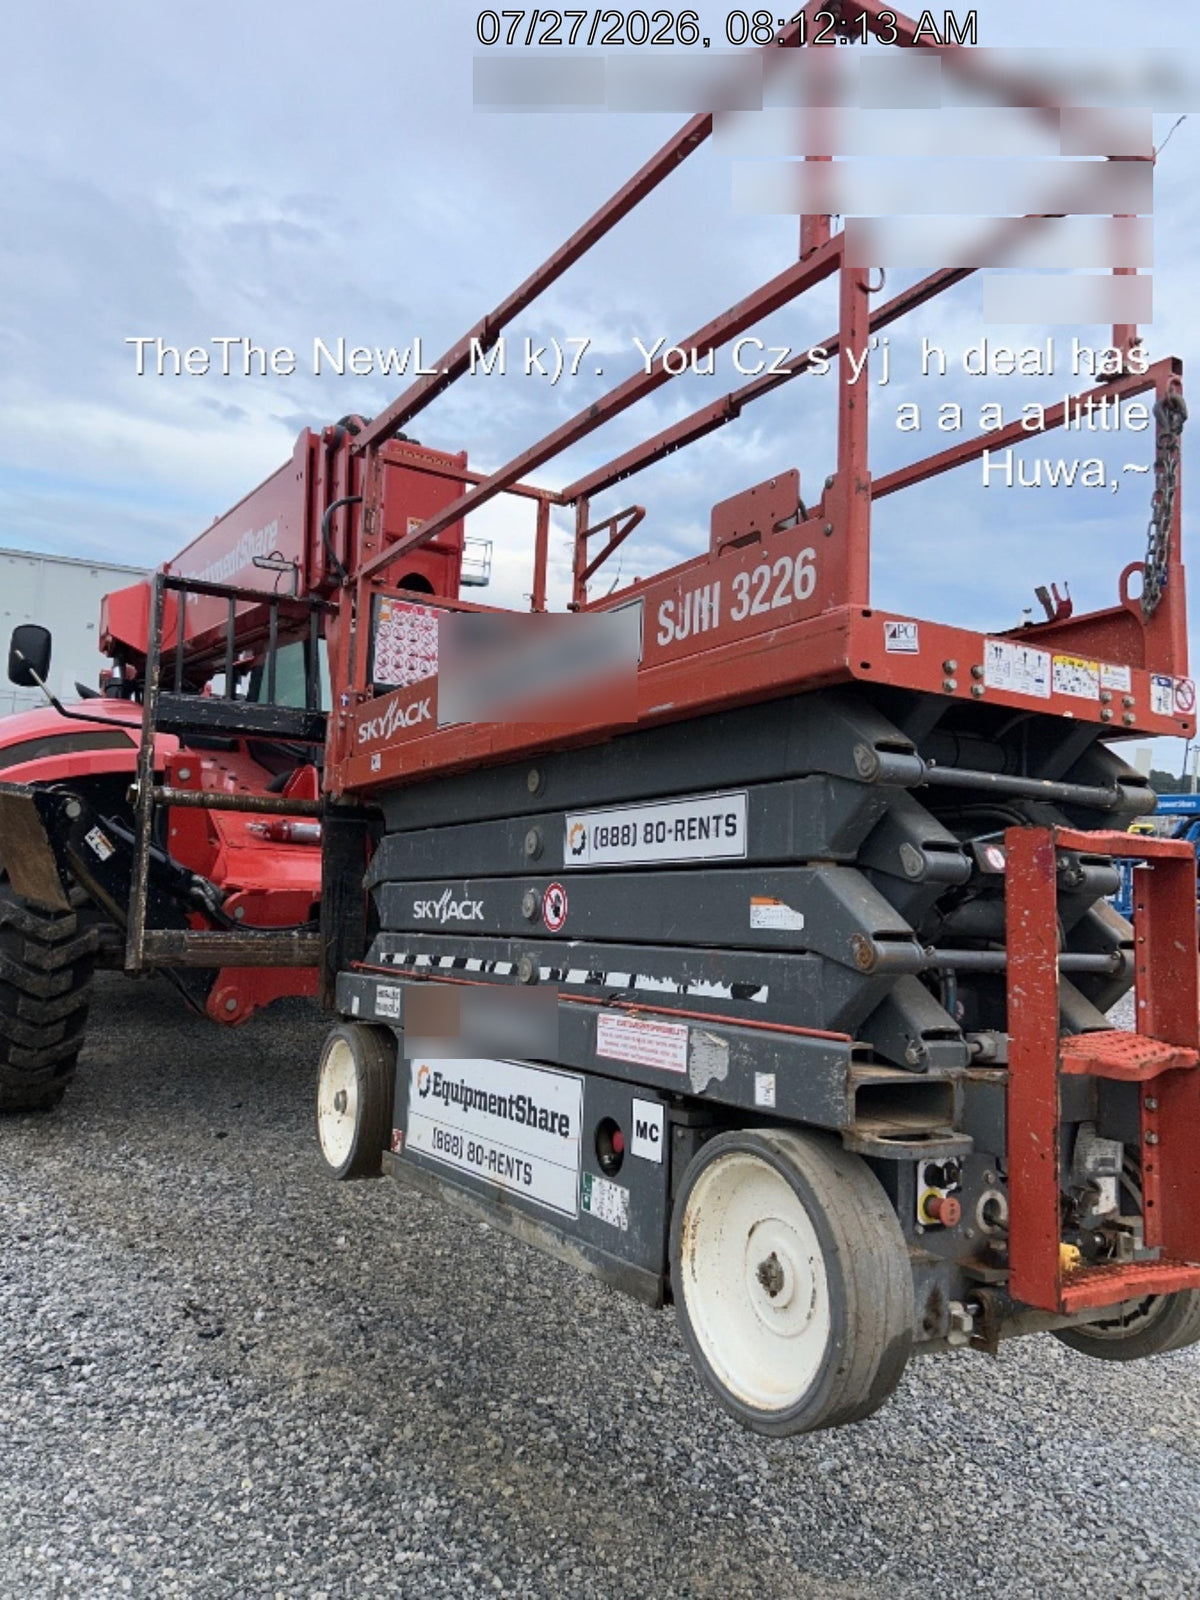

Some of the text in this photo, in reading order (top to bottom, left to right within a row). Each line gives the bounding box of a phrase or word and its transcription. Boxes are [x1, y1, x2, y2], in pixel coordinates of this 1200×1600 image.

[730, 547, 817, 622] 3226
[358, 696, 432, 745] SKYJACK
[593, 813, 737, 851] (888) 80-RENTS
[412, 887, 485, 924] SKYJACK
[431, 1071, 571, 1139] EquipmentShare
[635, 1119, 660, 1143] MC
[431, 1126, 533, 1187] (888) 80-RENTS
